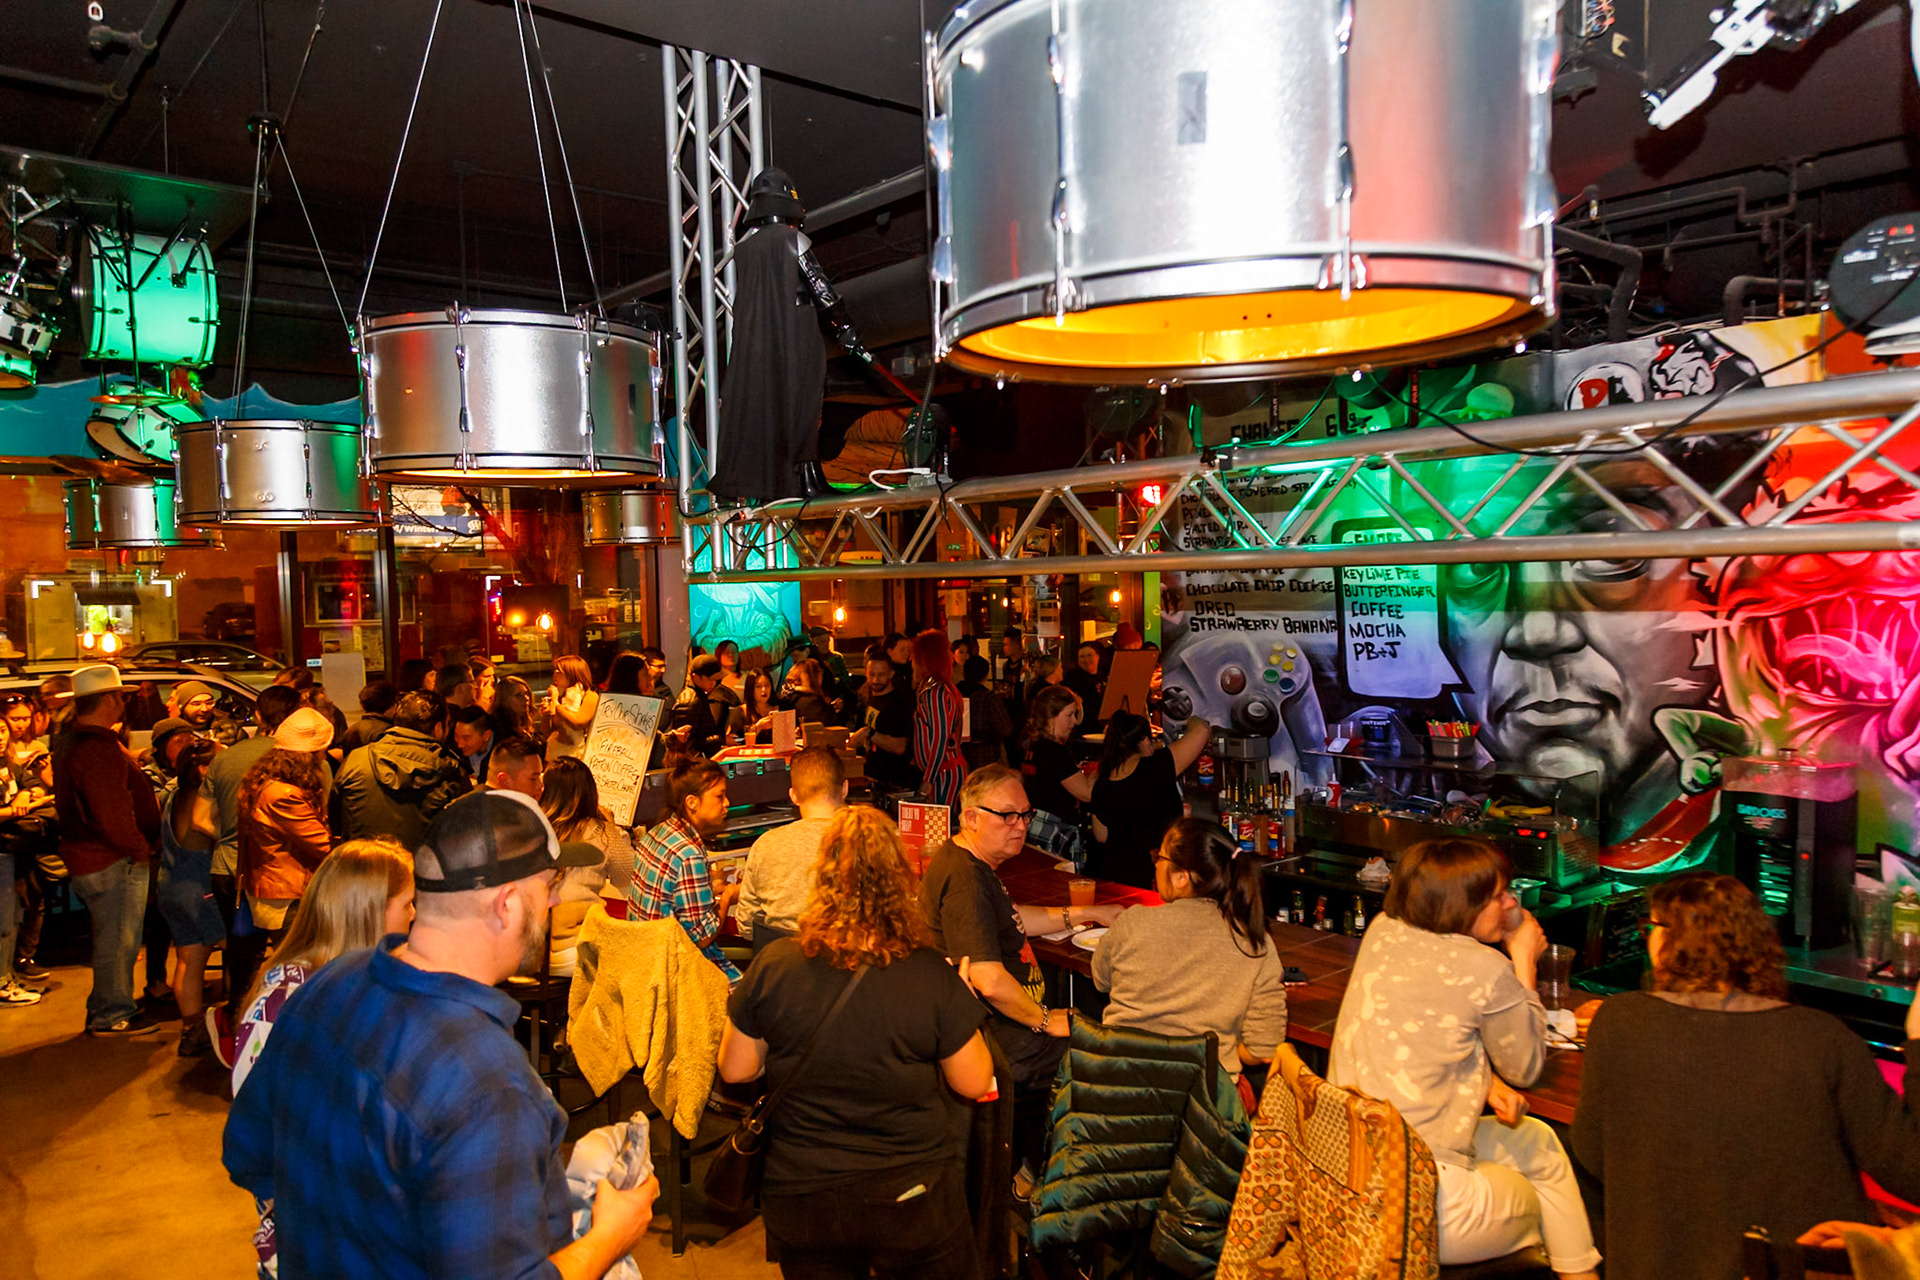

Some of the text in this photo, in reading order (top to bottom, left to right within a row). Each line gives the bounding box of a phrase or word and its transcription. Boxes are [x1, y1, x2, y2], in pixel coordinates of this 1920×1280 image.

[1343, 567, 1420, 582] KEY LIME PIE
[1186, 578, 1336, 597] CHOCOLATE CHIP COOKIE
[1343, 583, 1436, 598] BUTTERFINGER
[1350, 601, 1405, 619] COFFEE
[1189, 616, 1338, 635] STRAWBERRY BANANA
[1349, 621, 1407, 639] MOCHA
